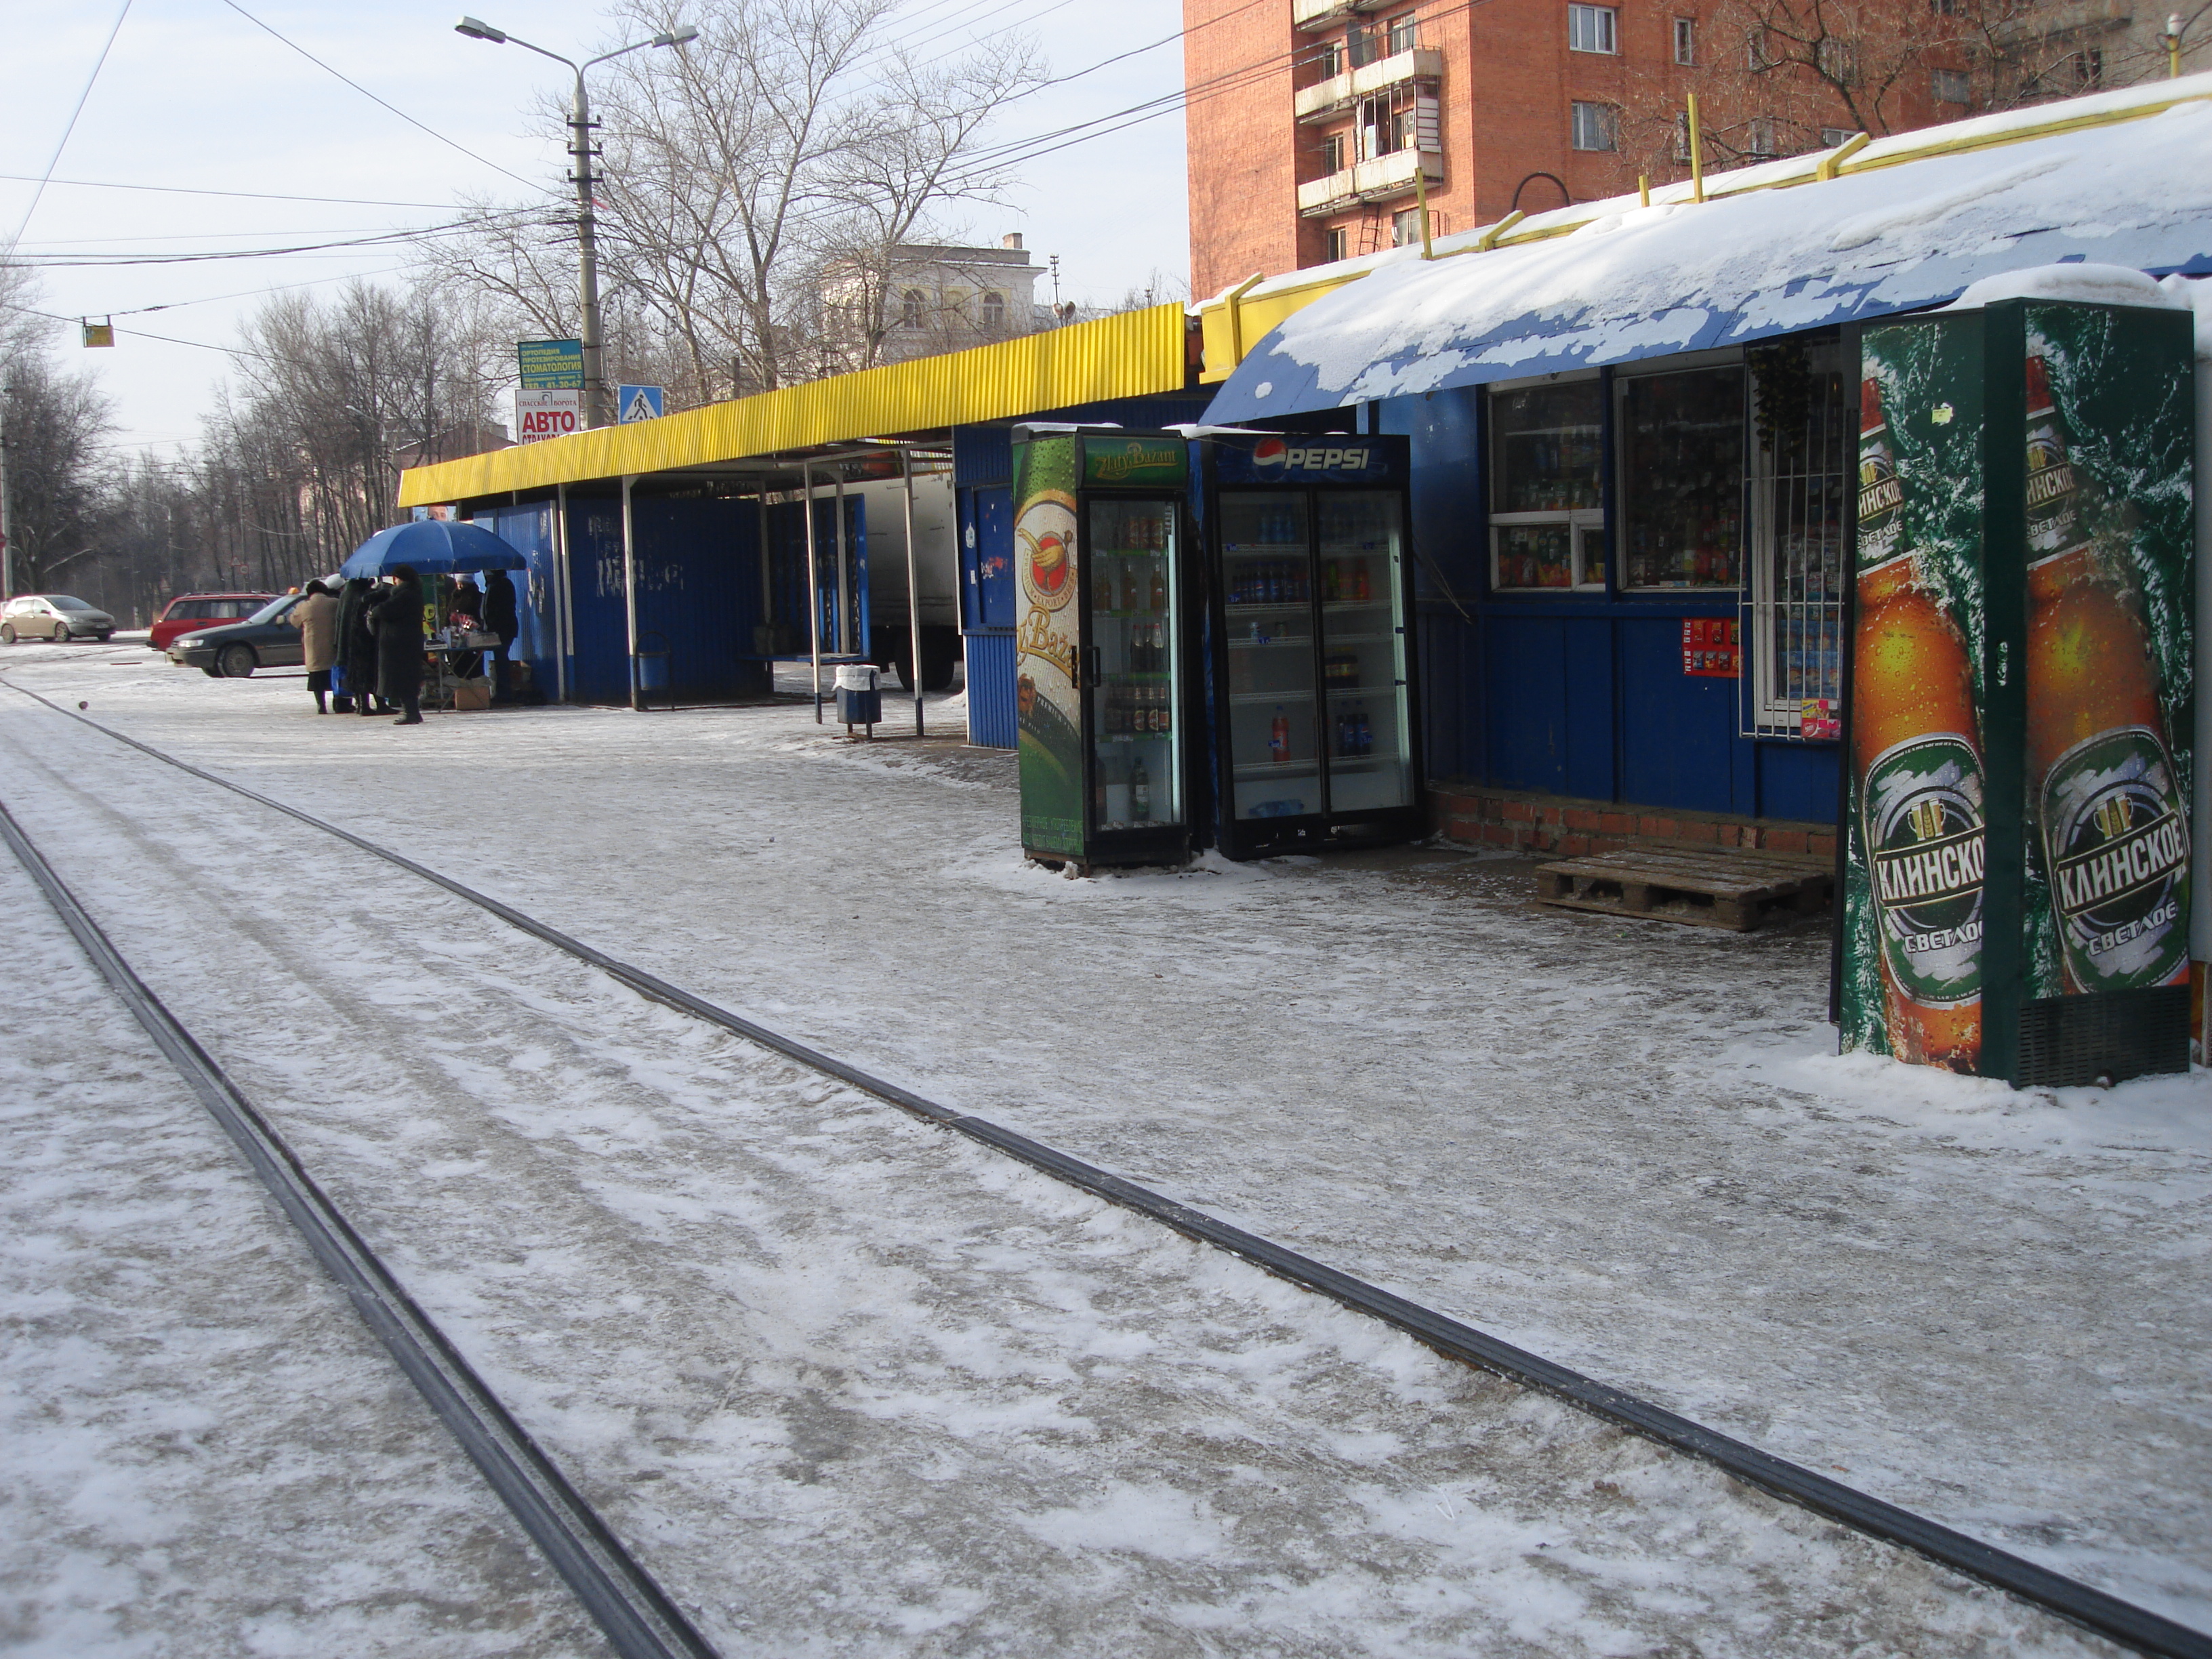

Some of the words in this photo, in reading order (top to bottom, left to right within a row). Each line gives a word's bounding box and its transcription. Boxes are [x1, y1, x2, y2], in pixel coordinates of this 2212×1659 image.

[521, 348, 560, 356] ОРТОПЕДИЯ
[522, 354, 581, 363] ПРОТЕЗИРОВАНИЕ
[522, 361, 582, 373] СТОМАТОЛОГИЯ
[547, 380, 581, 388] 41-30-67
[522, 411, 575, 432] АВТО
[1284, 449, 1370, 470] PEPSI
[1036, 596, 1061, 607] EXPORT
[2058, 816, 2185, 911] КЛИНСКОЕ
[2088, 901, 2177, 956] СВЕТЛОЕ
